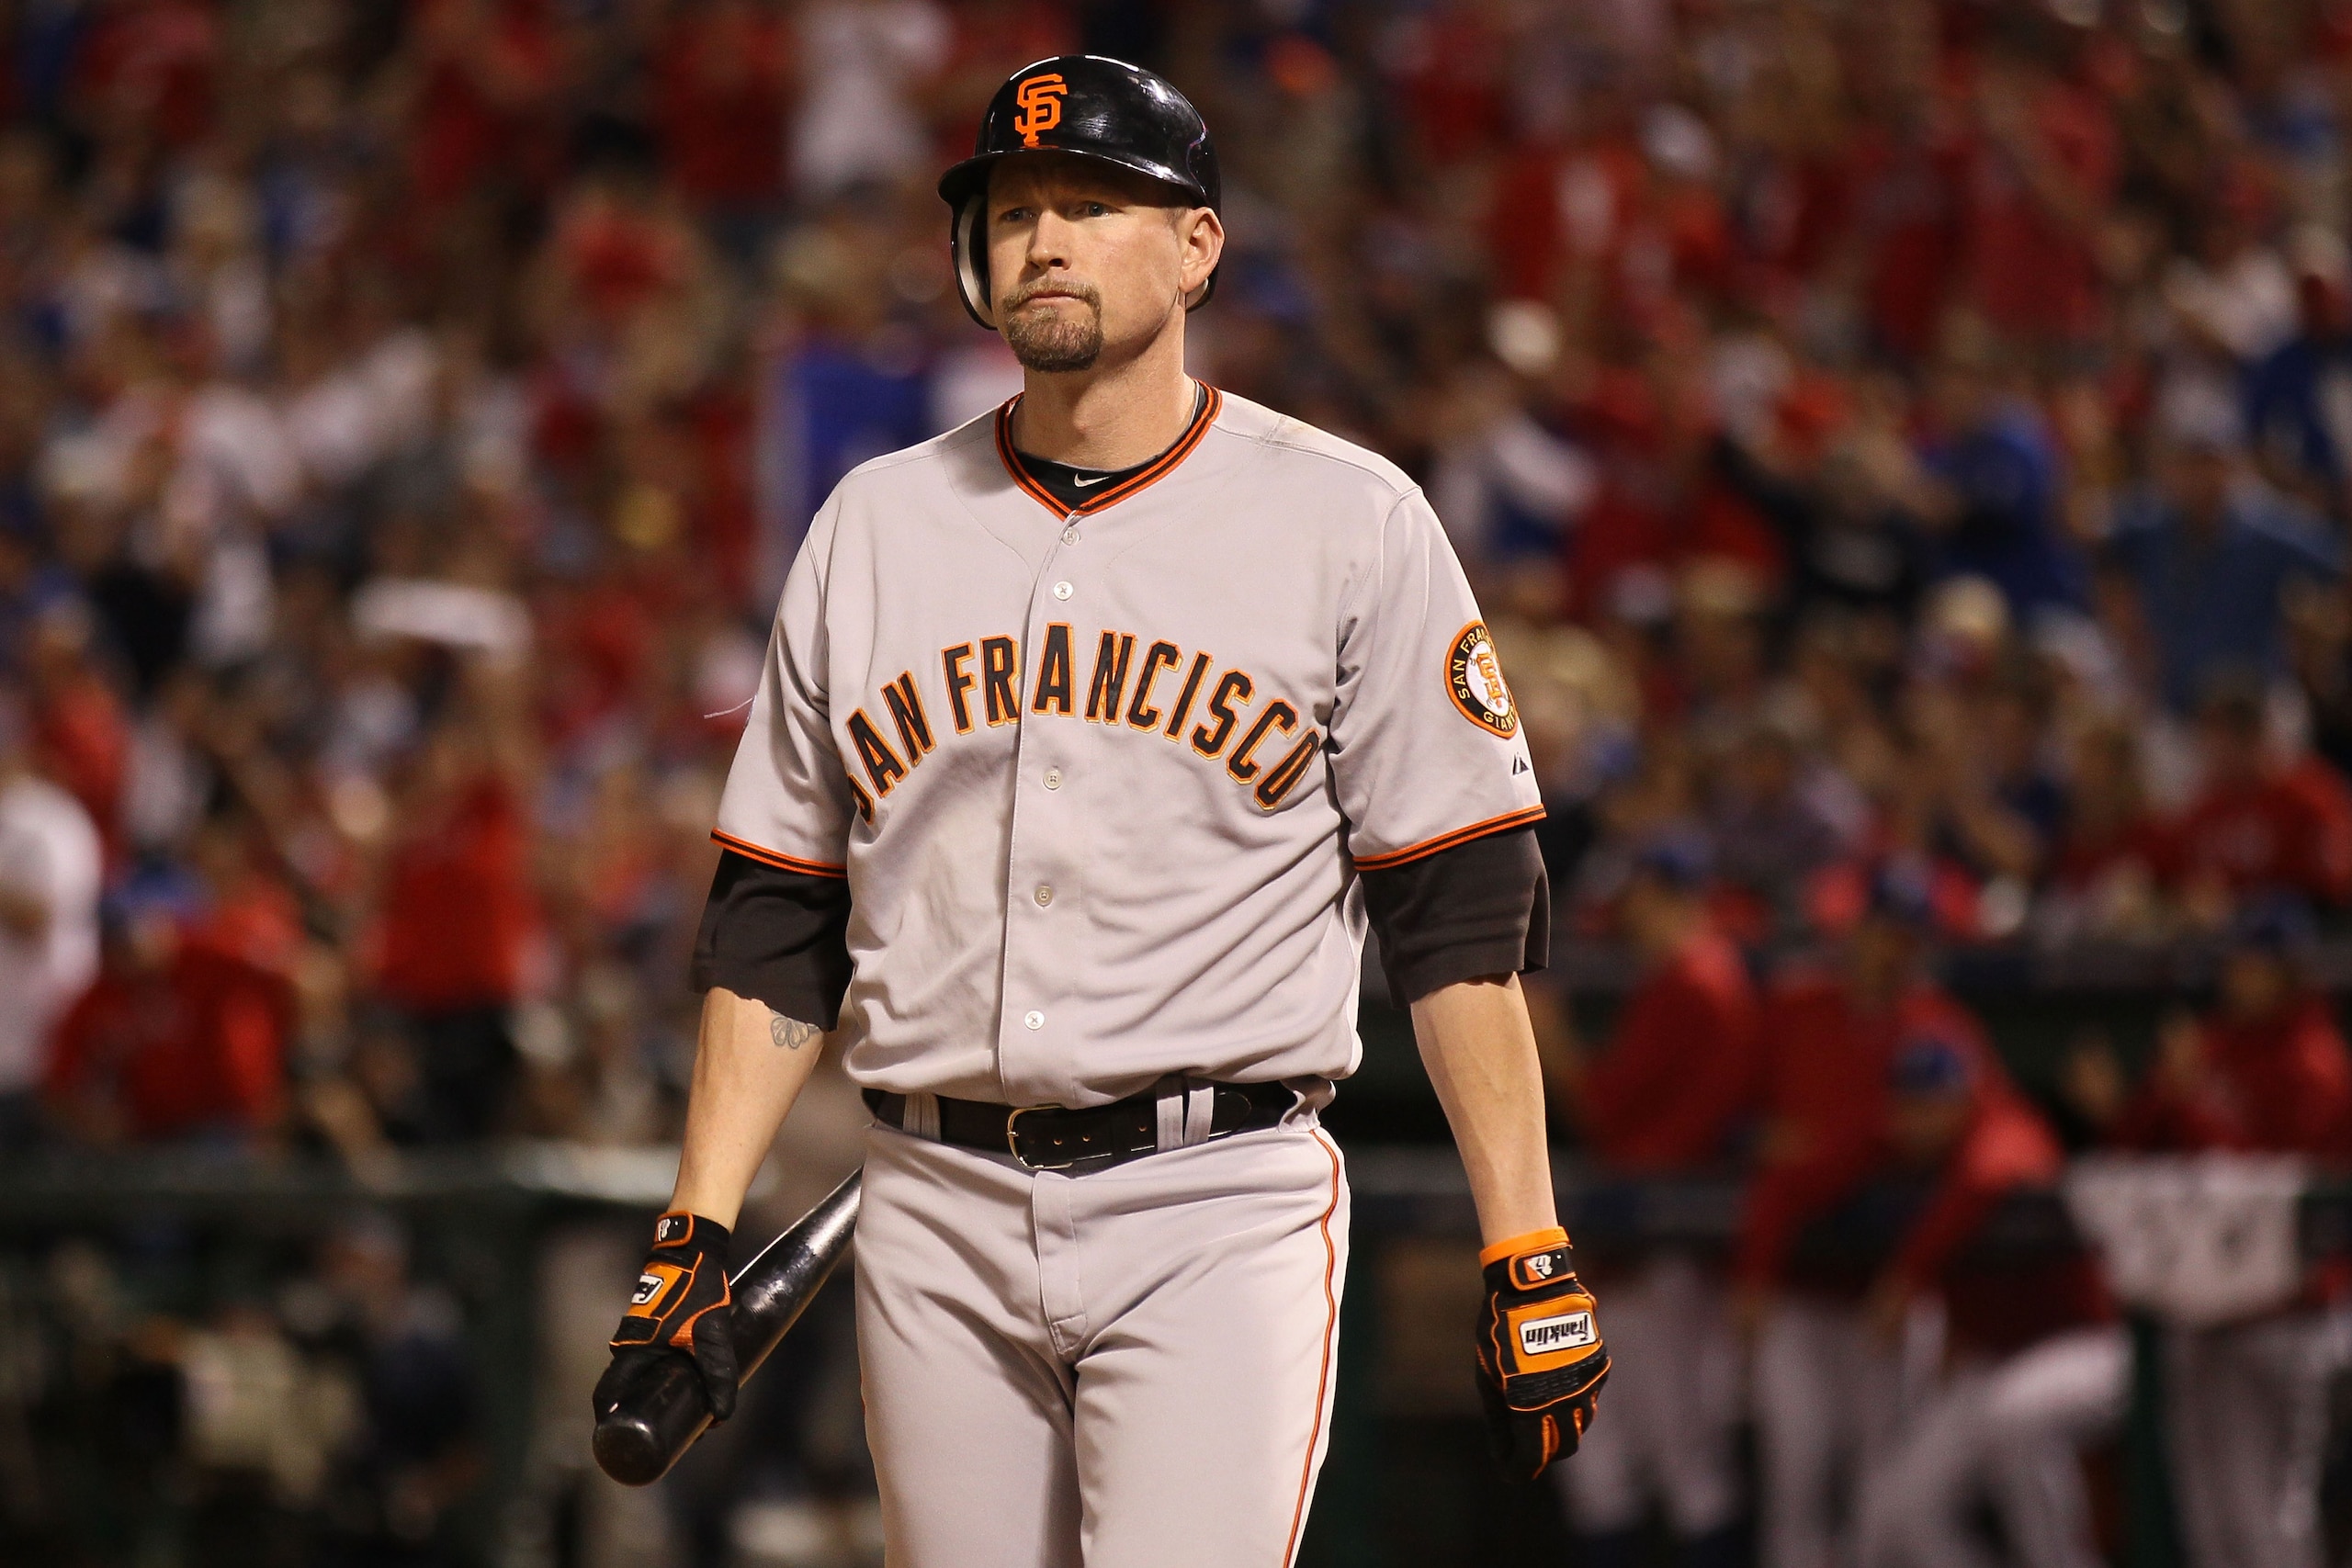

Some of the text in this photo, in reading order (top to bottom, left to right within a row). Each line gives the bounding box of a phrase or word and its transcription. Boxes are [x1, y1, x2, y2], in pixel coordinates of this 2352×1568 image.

[1014, 73, 1068, 146] SF
[1453, 659, 1471, 700] SAN
[941, 622, 1321, 812] FRANCISCO
[1525, 1314, 1589, 1346] Franklin
